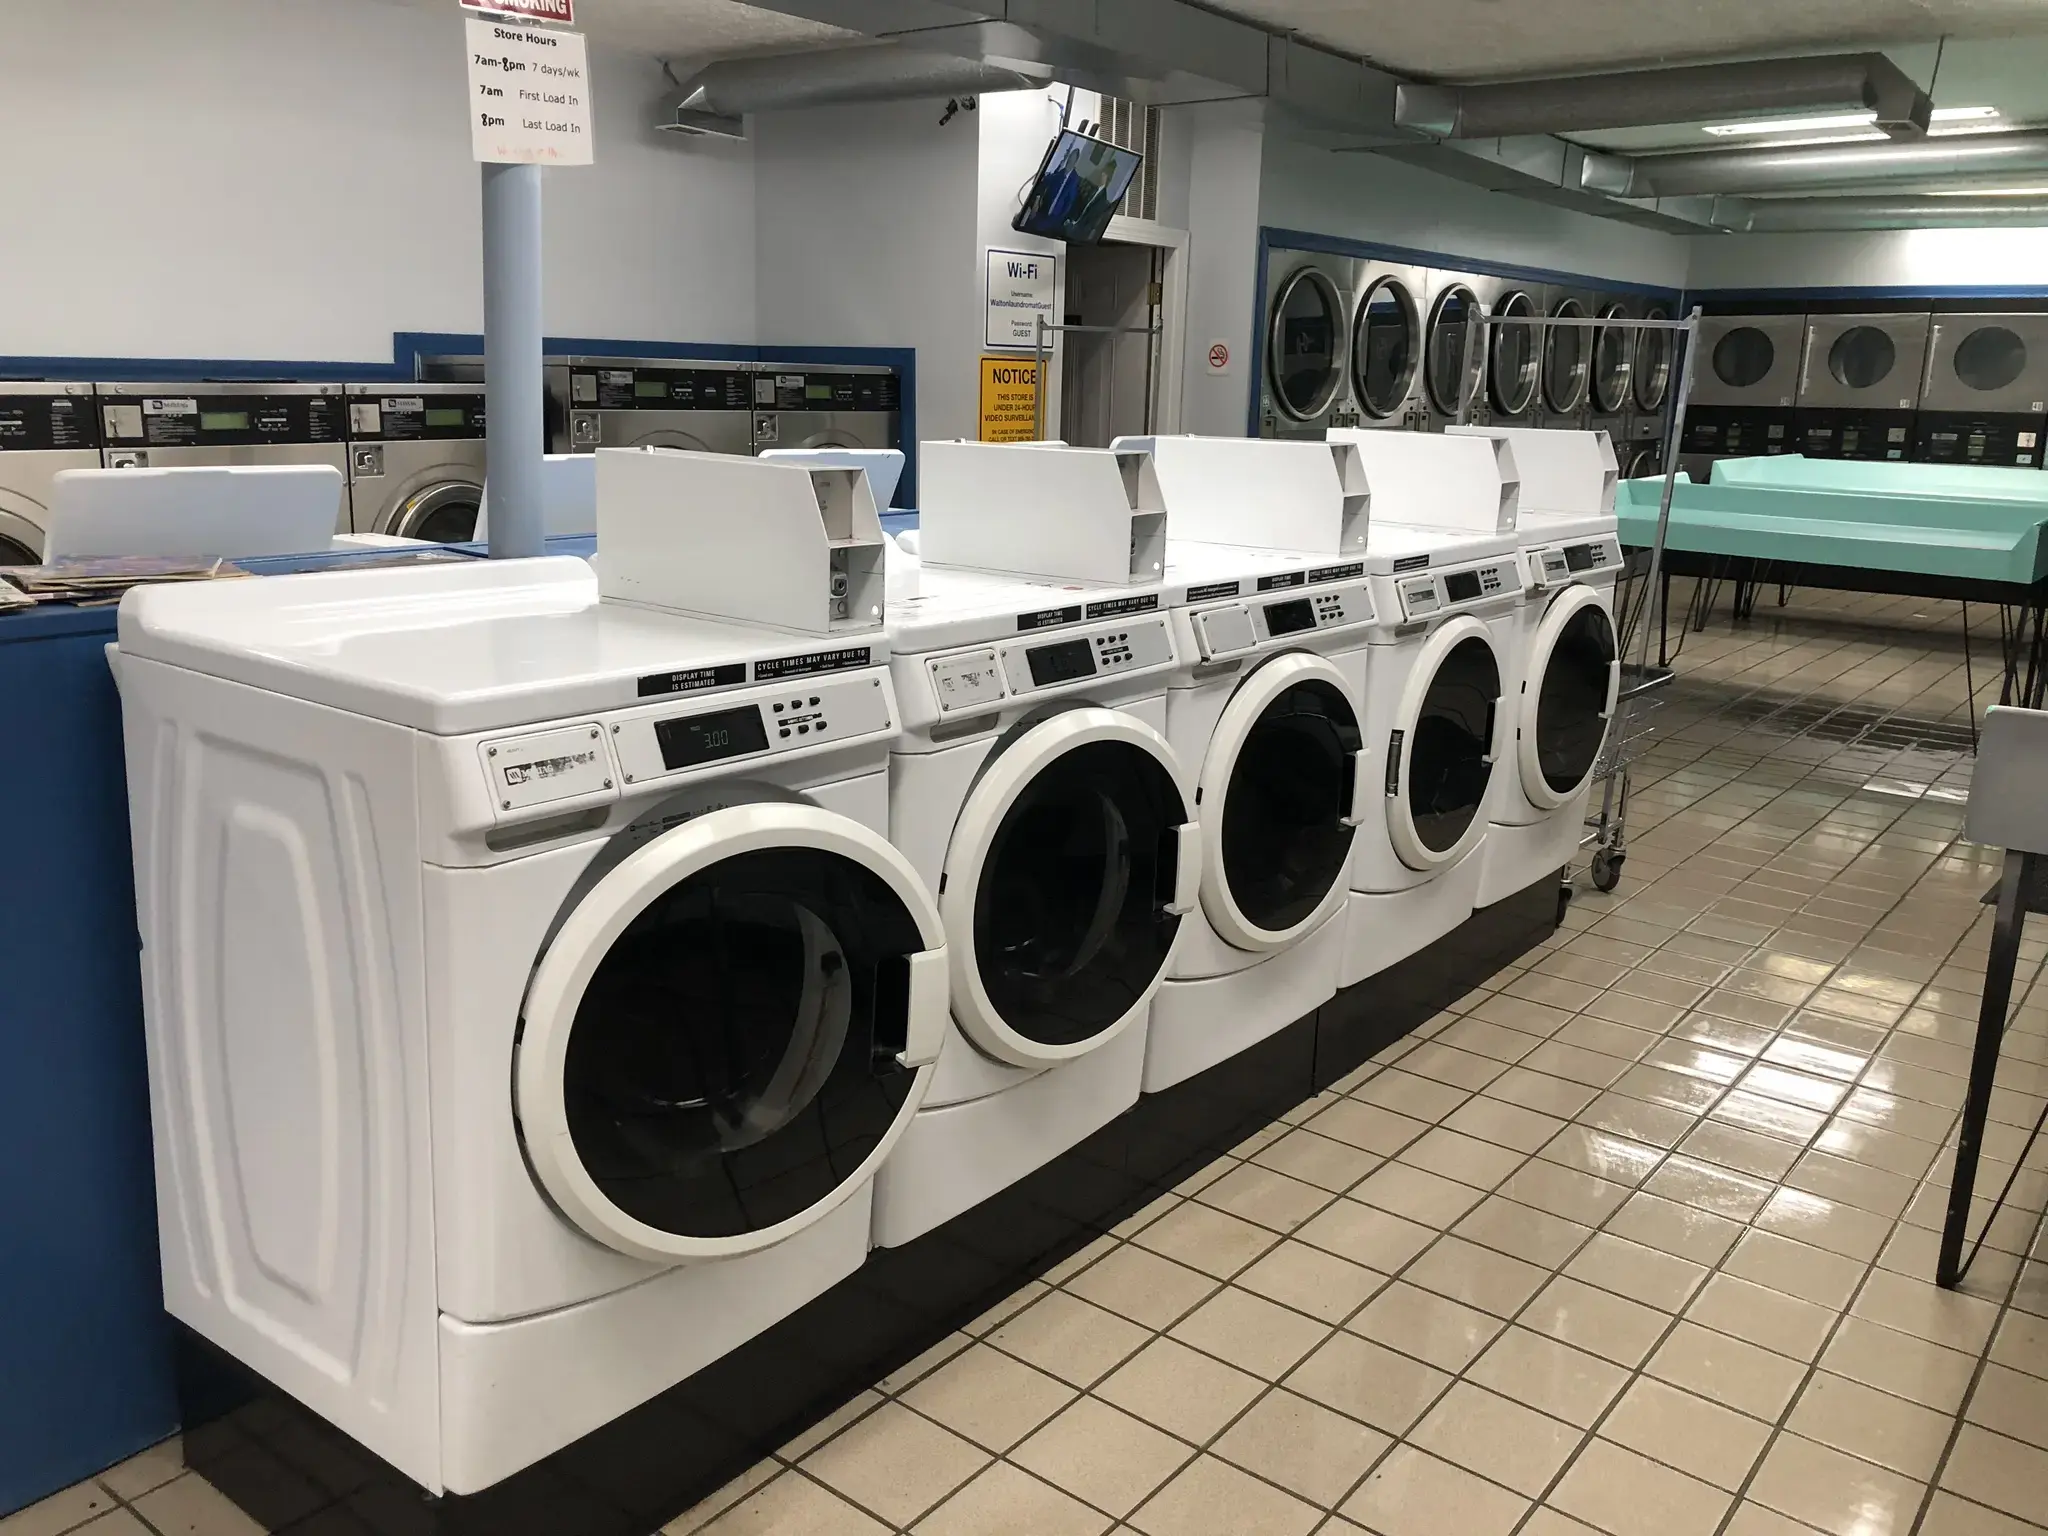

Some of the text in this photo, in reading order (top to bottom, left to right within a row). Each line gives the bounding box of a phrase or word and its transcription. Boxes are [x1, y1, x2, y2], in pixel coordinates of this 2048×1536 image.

[494, 28, 557, 47] Store Hours
[474, 54, 580, 78] 7am-8pm 7 days/wk
[480, 84, 578, 106] 7am First Load In
[481, 113, 581, 133] 8pm Last Load In
[1007, 262, 1038, 280] Wi-Fi
[1012, 329, 1031, 337] GUEST
[993, 368, 1036, 384] NOTICE
[997, 393, 1010, 401] THIS
[985, 414, 1003, 422] VIDEO
[757, 661, 779, 671] CYCLE
[782, 657, 804, 667] TIMES
[806, 655, 821, 664] MAY
[823, 652, 840, 661] VARY
[842, 650, 855, 659] DUE
[672, 669, 715, 682] DISPLAY TIME
[680, 678, 715, 690] ESTIMATED
